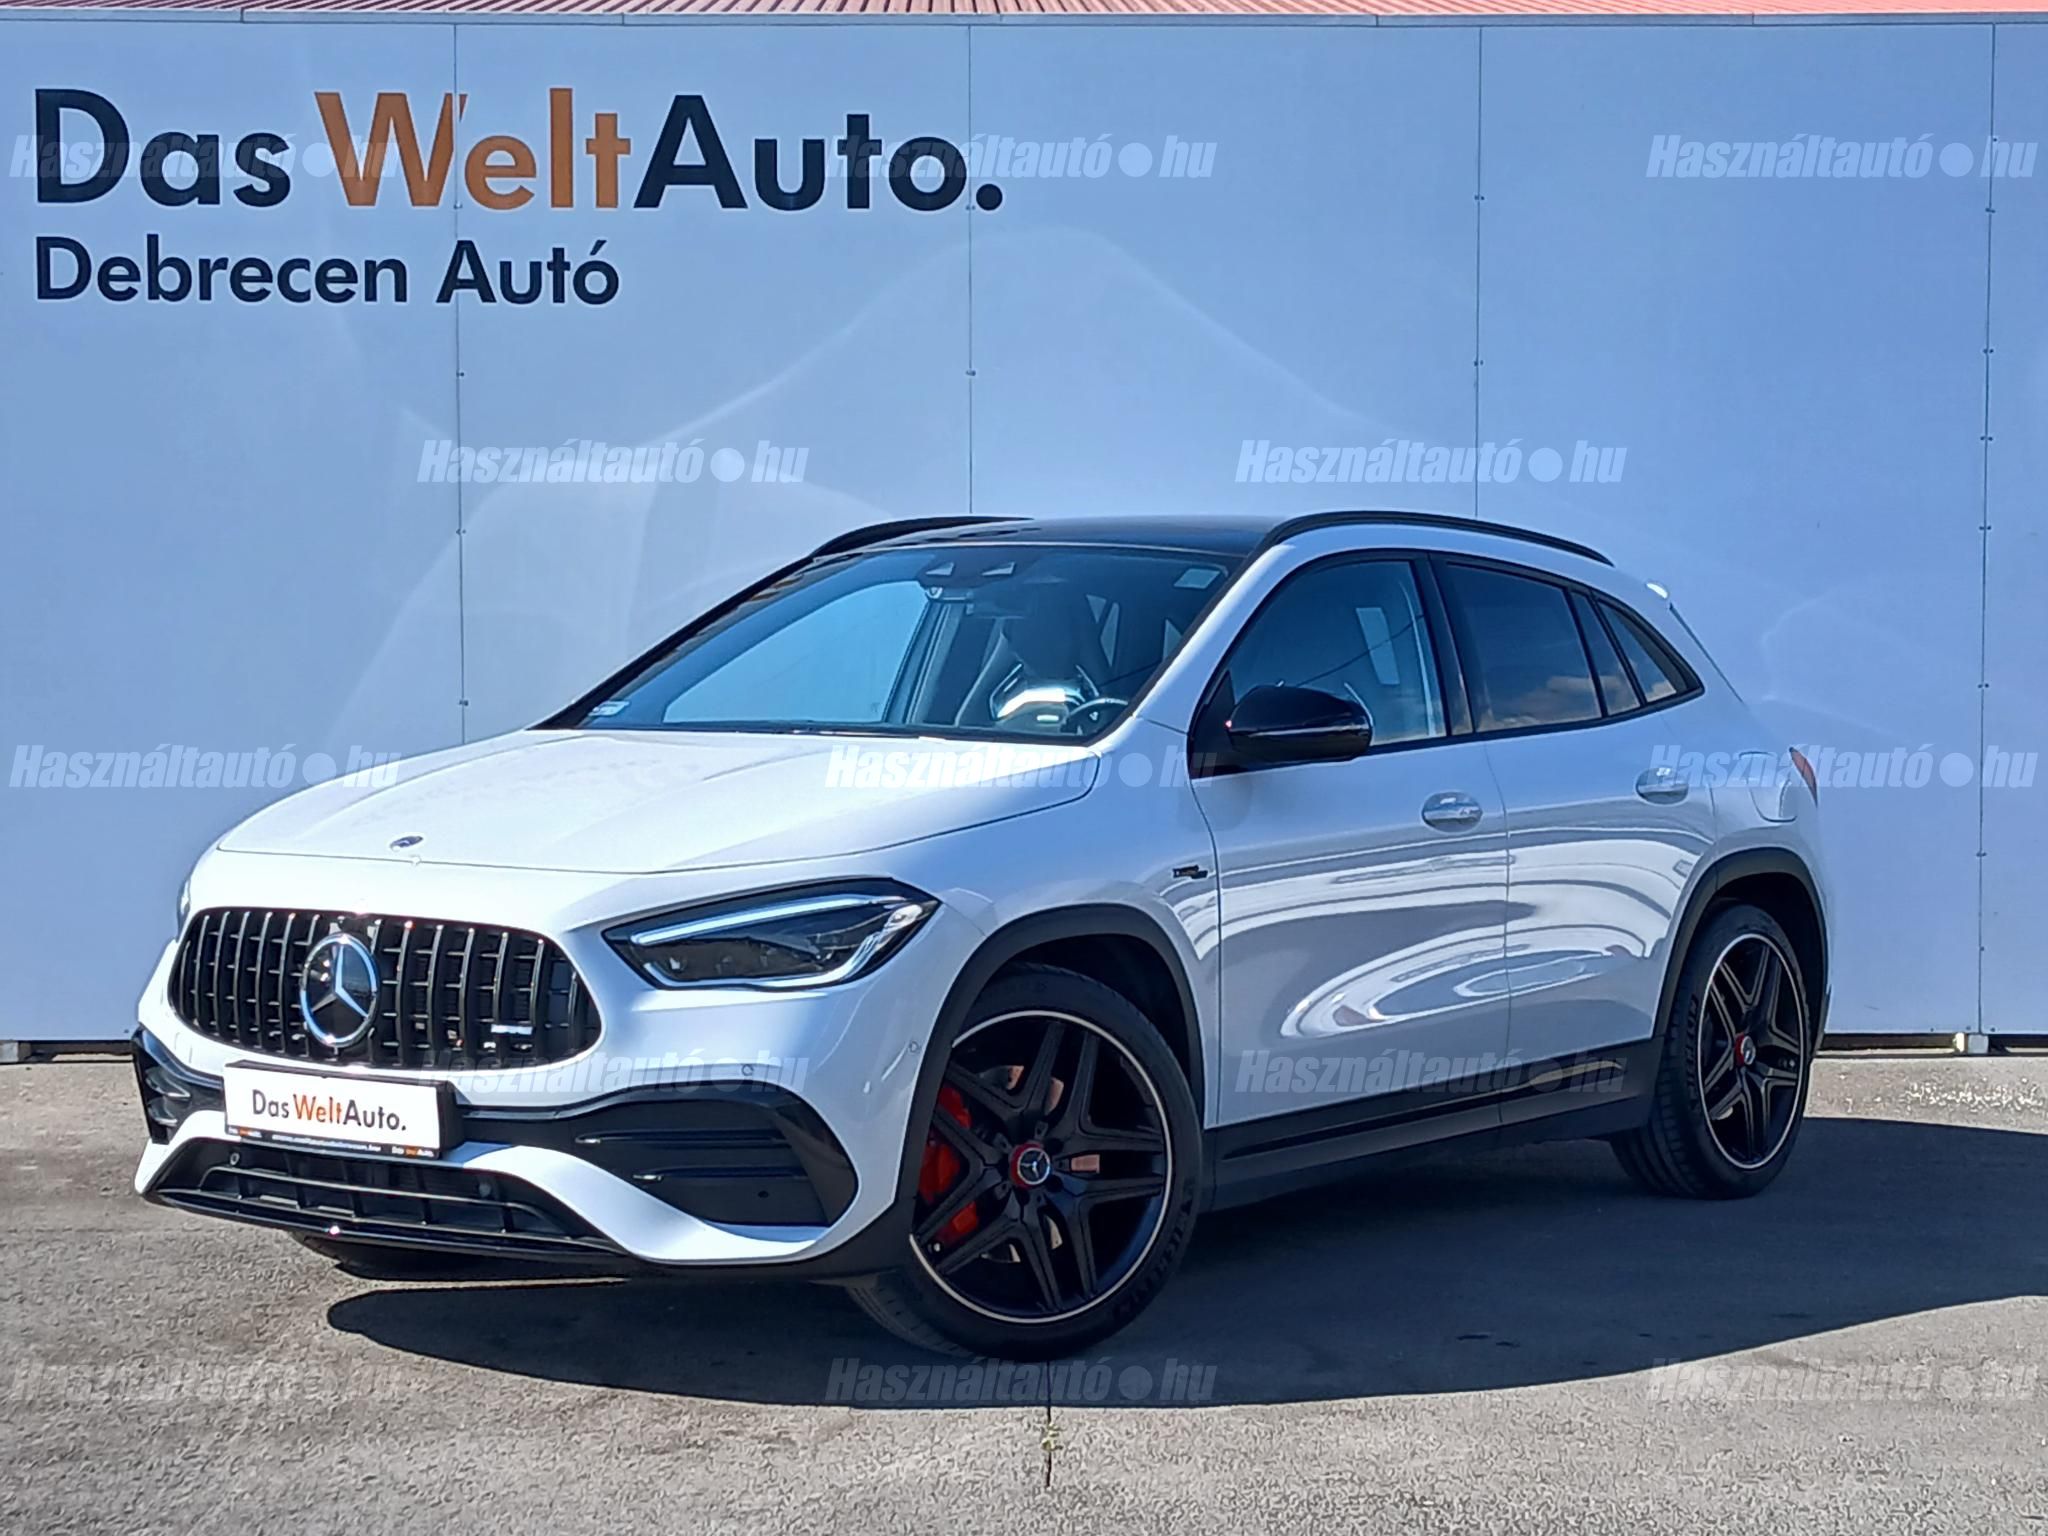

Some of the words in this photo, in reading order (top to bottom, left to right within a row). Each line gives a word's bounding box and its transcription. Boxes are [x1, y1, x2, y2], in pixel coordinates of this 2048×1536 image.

[35, 88, 291, 208] Das
[36, 234, 407, 302] Debrecen
[436, 240, 619, 305] Autó
[252, 1089, 290, 1119] Das
